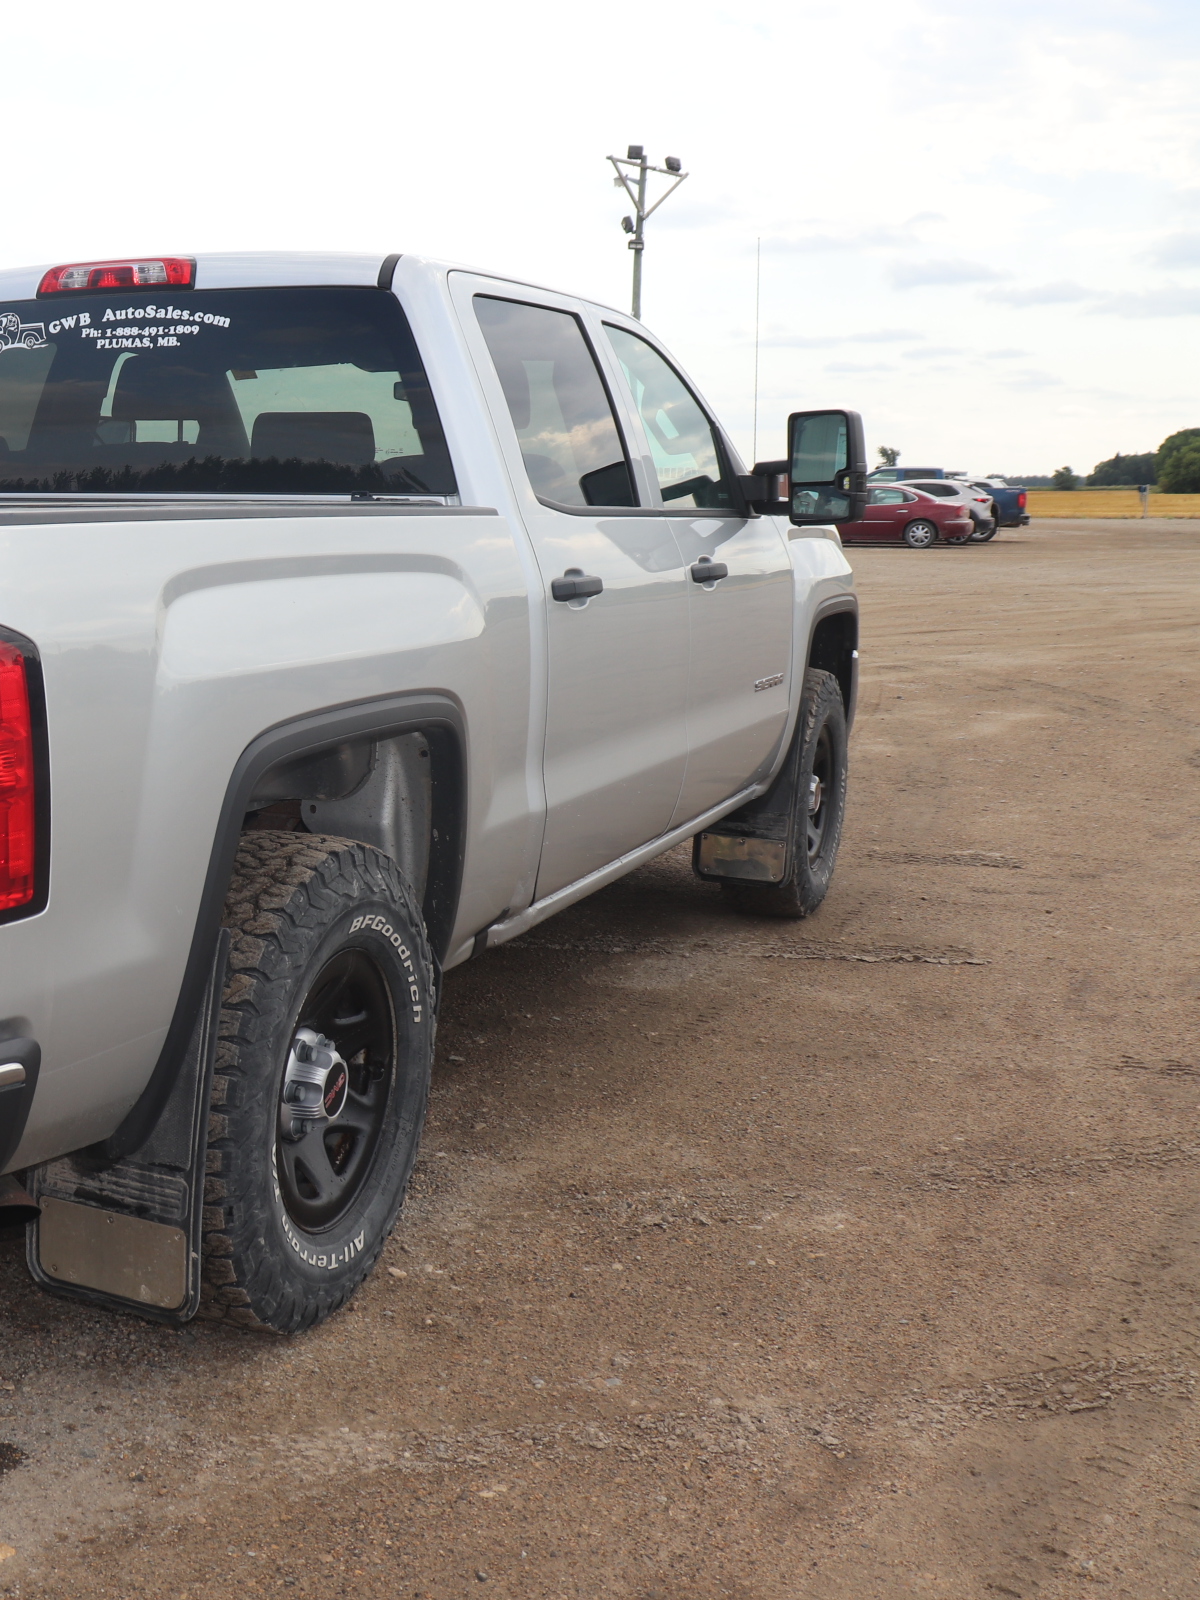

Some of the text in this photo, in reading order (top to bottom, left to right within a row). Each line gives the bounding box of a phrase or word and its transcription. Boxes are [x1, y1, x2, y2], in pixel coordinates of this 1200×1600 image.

[48, 305, 231, 334] GWB AutoSales.com
[81, 325, 200, 338] Ph: 1-888-491-1809
[96, 336, 181, 350] PLUMAS, MB.
[348, 914, 423, 1023] BFGoodrich
[282, 1214, 365, 1270] All-Terrain
